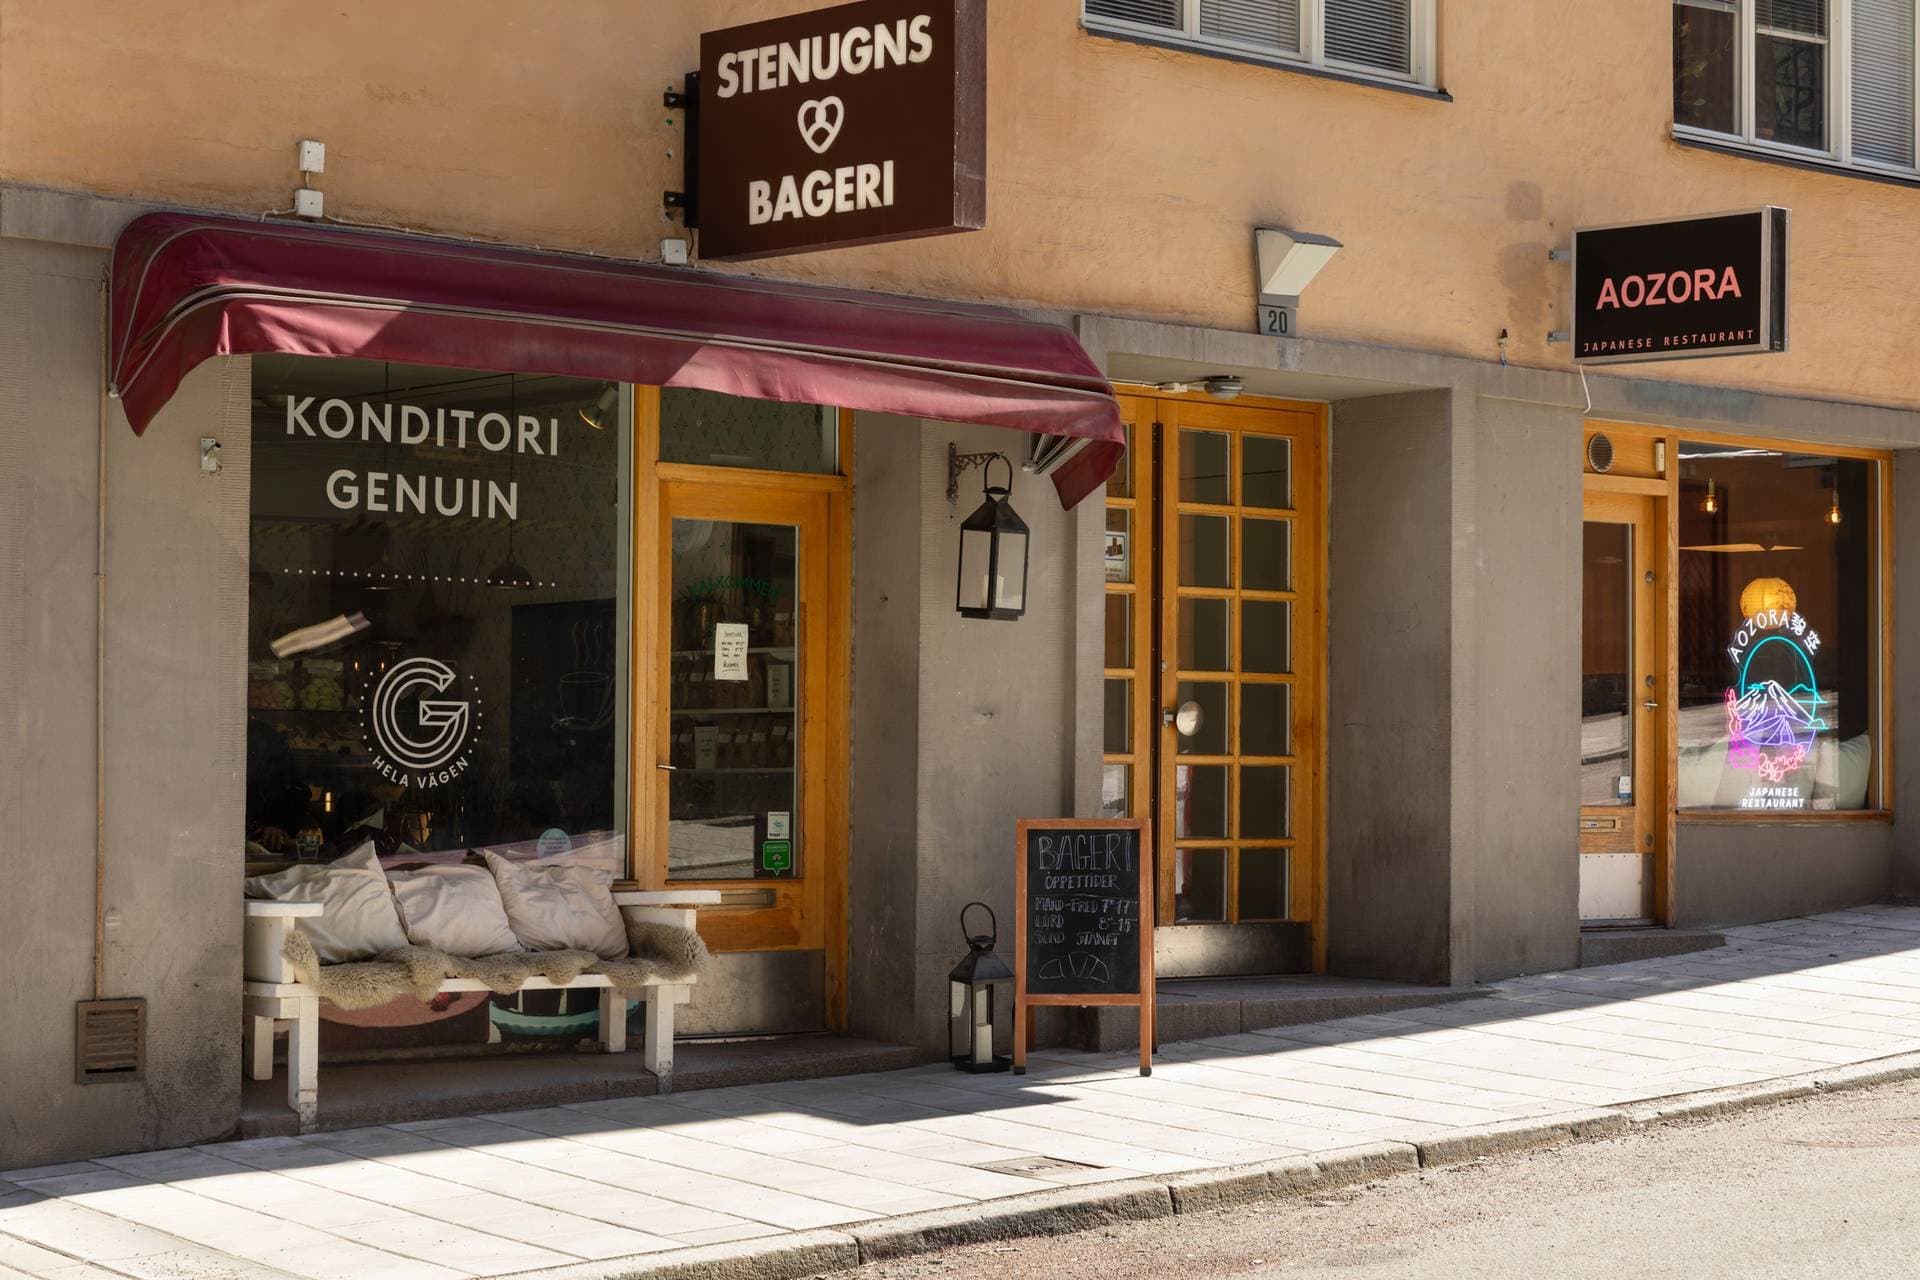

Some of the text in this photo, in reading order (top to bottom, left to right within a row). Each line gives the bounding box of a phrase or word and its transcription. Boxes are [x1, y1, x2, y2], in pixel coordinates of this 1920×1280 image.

[716, 14, 933, 99] STENUGNS
[749, 160, 894, 225] BAGERI
[1595, 265, 1743, 311] AOZORA
[1268, 310, 1288, 334] 20
[1583, 329, 1754, 352] JAPANESE RESTAURANT
[286, 394, 559, 456] KONDITORI
[326, 469, 518, 520] GENUIN
[1730, 608, 1790, 664] AOZORA
[372, 755, 469, 789] HELA VÄGEN
[1749, 787, 1799, 797] JAPANESE
[1741, 798, 1805, 808] RESTAURANT
[1038, 832, 1133, 872] BAGERI
